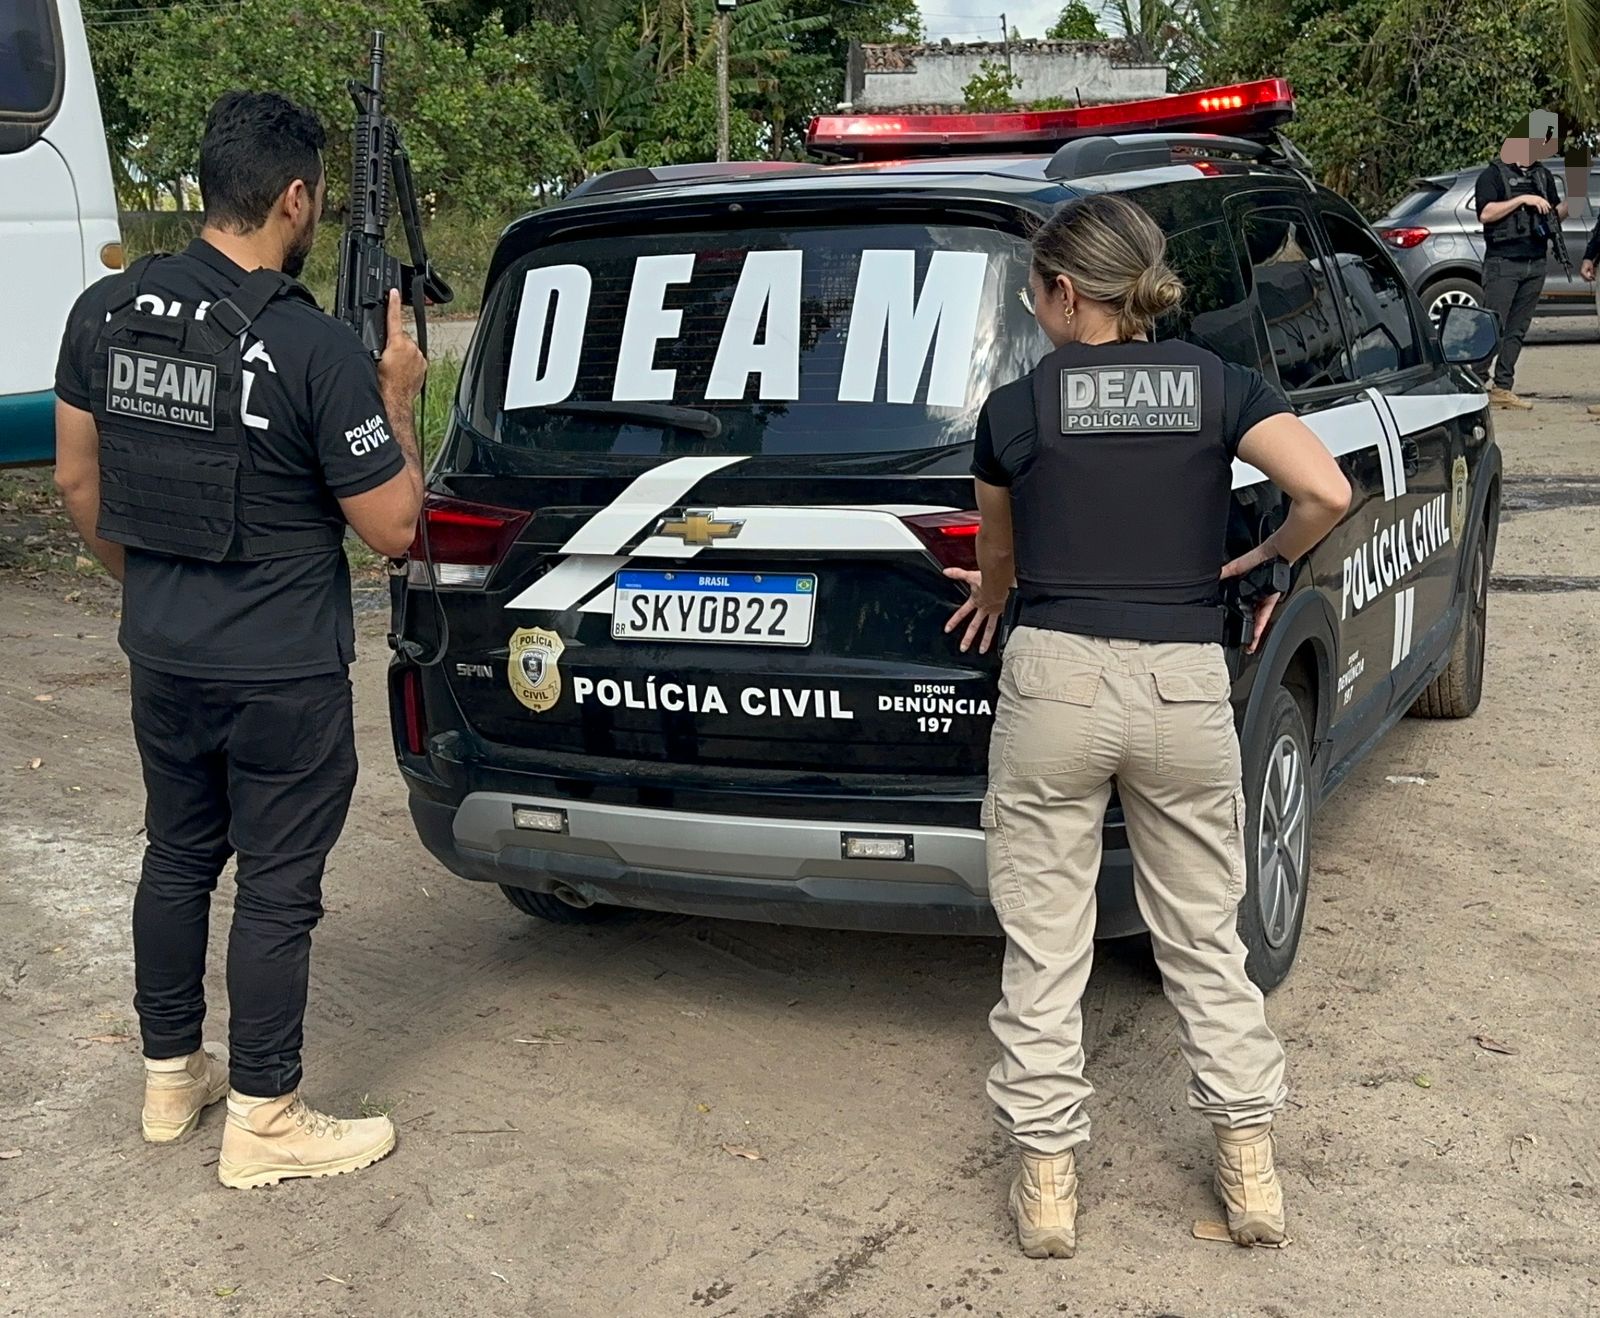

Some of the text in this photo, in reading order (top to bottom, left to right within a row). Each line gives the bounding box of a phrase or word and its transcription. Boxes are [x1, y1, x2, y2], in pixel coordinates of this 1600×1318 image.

[504, 250, 988, 410] DEAM
[112, 353, 212, 406] DEAM
[1067, 370, 1195, 409] DEAM
[111, 395, 209, 425] POLÍCIA CIVIL
[1067, 411, 1194, 428] POLÍCIA CIVIL
[350, 426, 390, 457] CIVIL
[1341, 493, 1450, 621] POLÍCIA CIVIL
[698, 576, 730, 587] BRASIL
[629, 594, 789, 637] SKY0B22
[615, 622, 626, 635] BR
[519, 634, 553, 649] POLÍCIA
[456, 663, 493, 678] SPIN
[523, 689, 549, 700] CIVIL
[573, 676, 854, 719] POLÍCIA CIVIL
[914, 684, 956, 695] DISQUE
[878, 693, 992, 715] DENÚNCIA
[917, 716, 953, 734] 197
